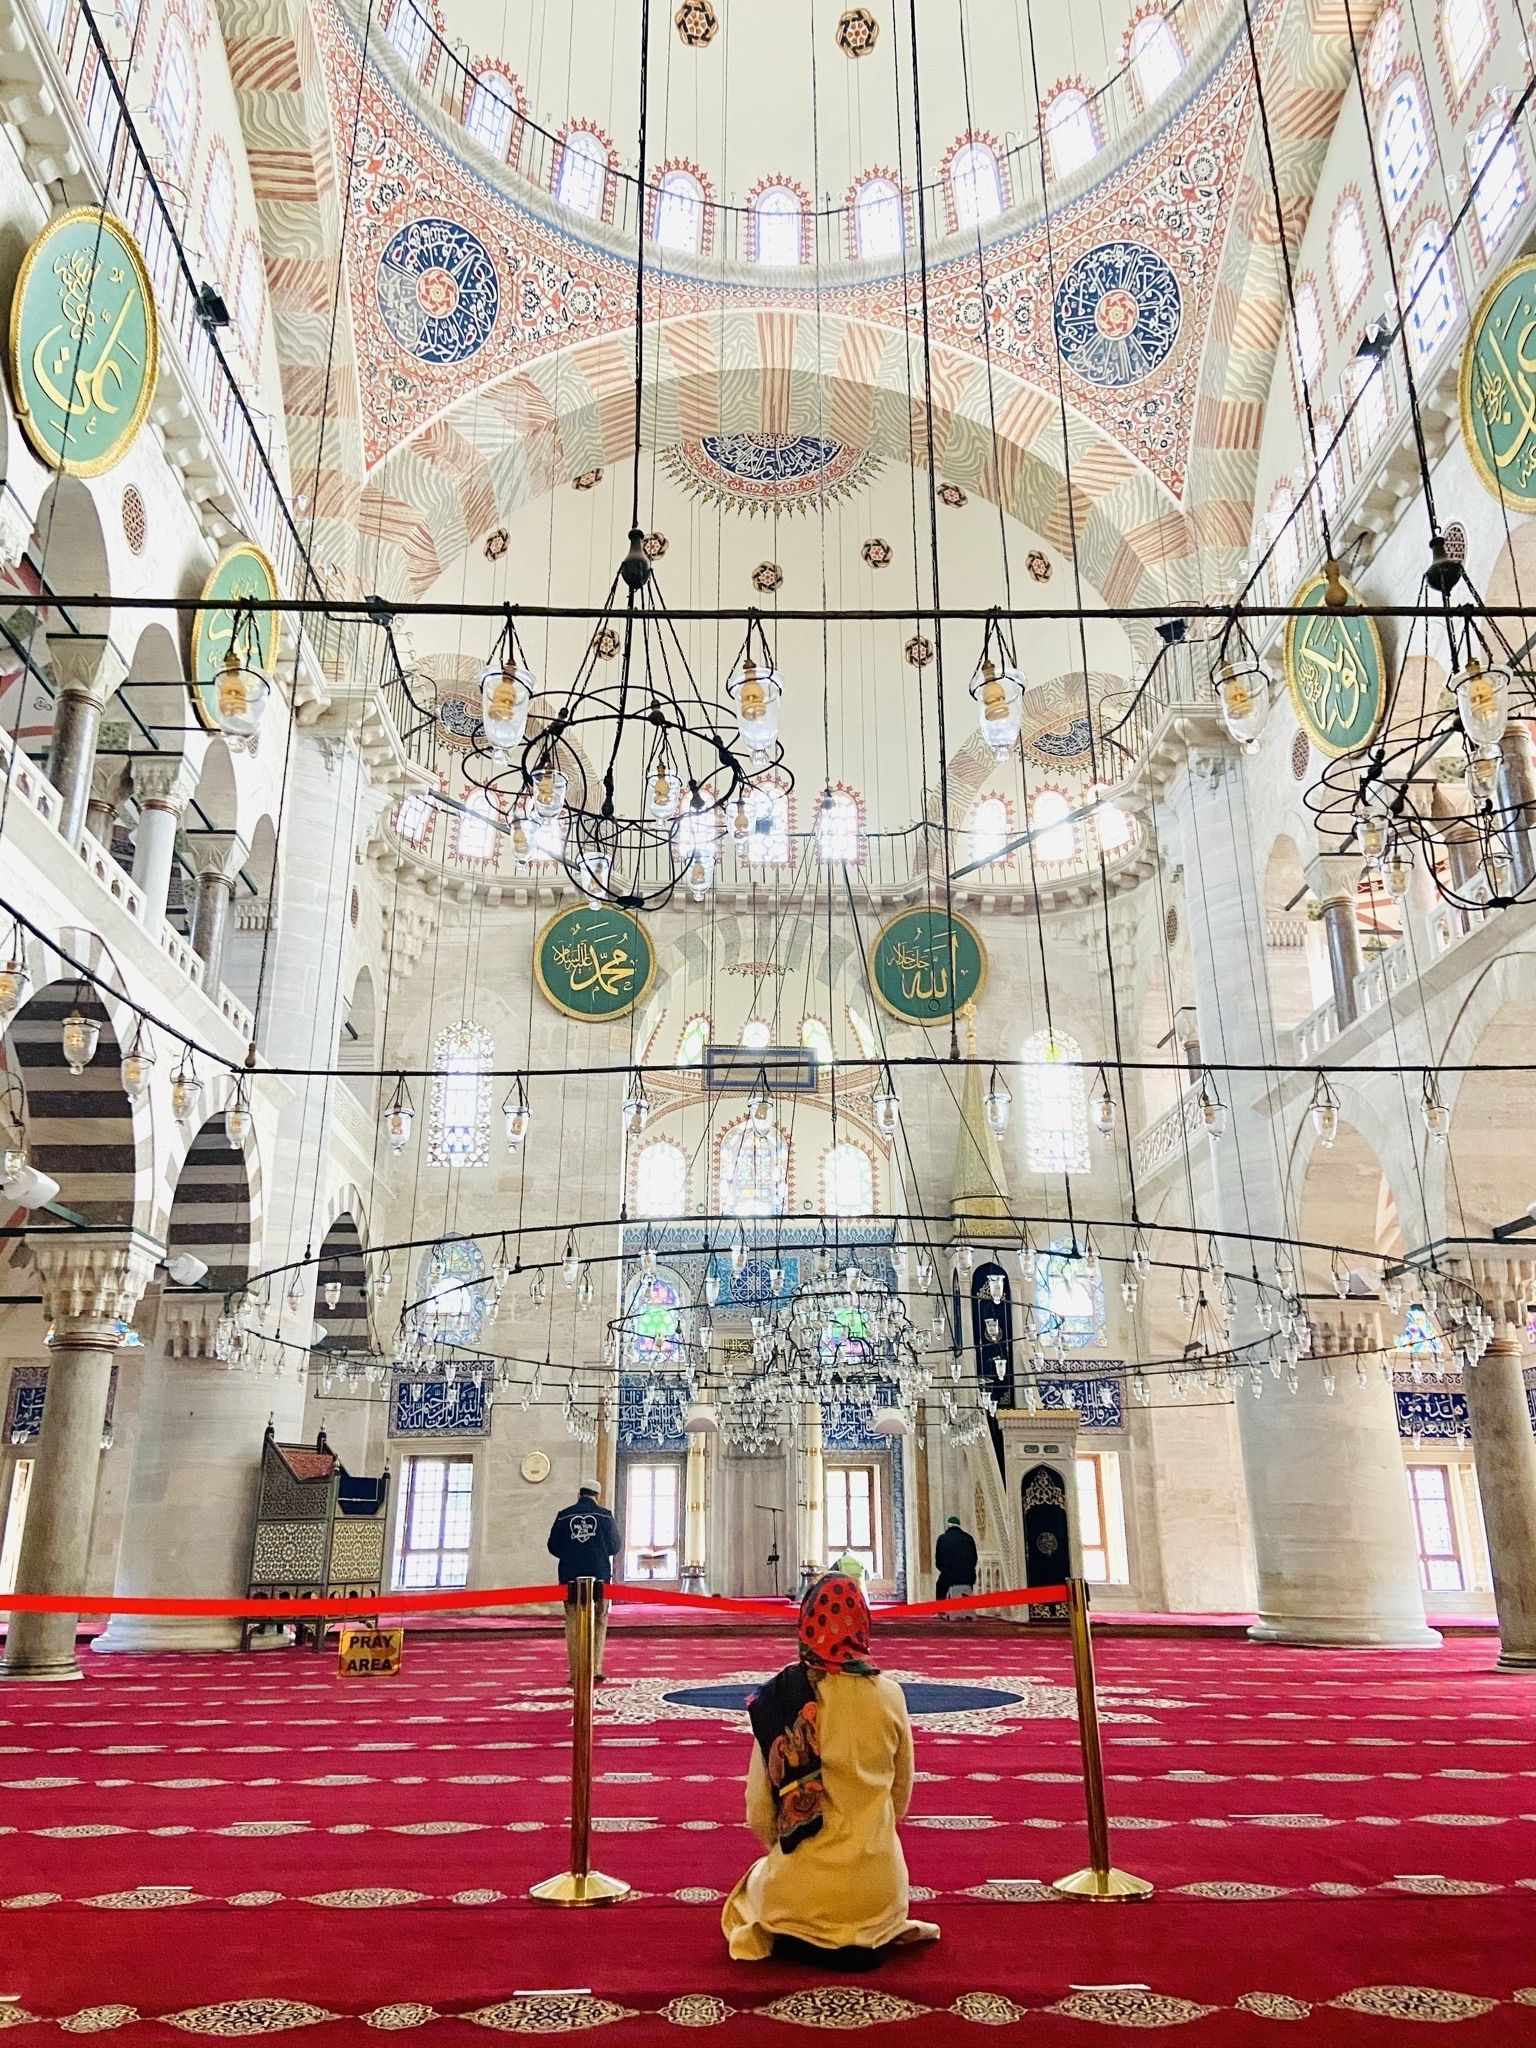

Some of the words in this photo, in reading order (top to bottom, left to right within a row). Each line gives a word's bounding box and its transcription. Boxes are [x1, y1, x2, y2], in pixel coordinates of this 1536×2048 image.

[902, 934, 958, 999] الله
[350, 1635, 393, 1648] PRAY
[346, 1658, 392, 1671] AREA
